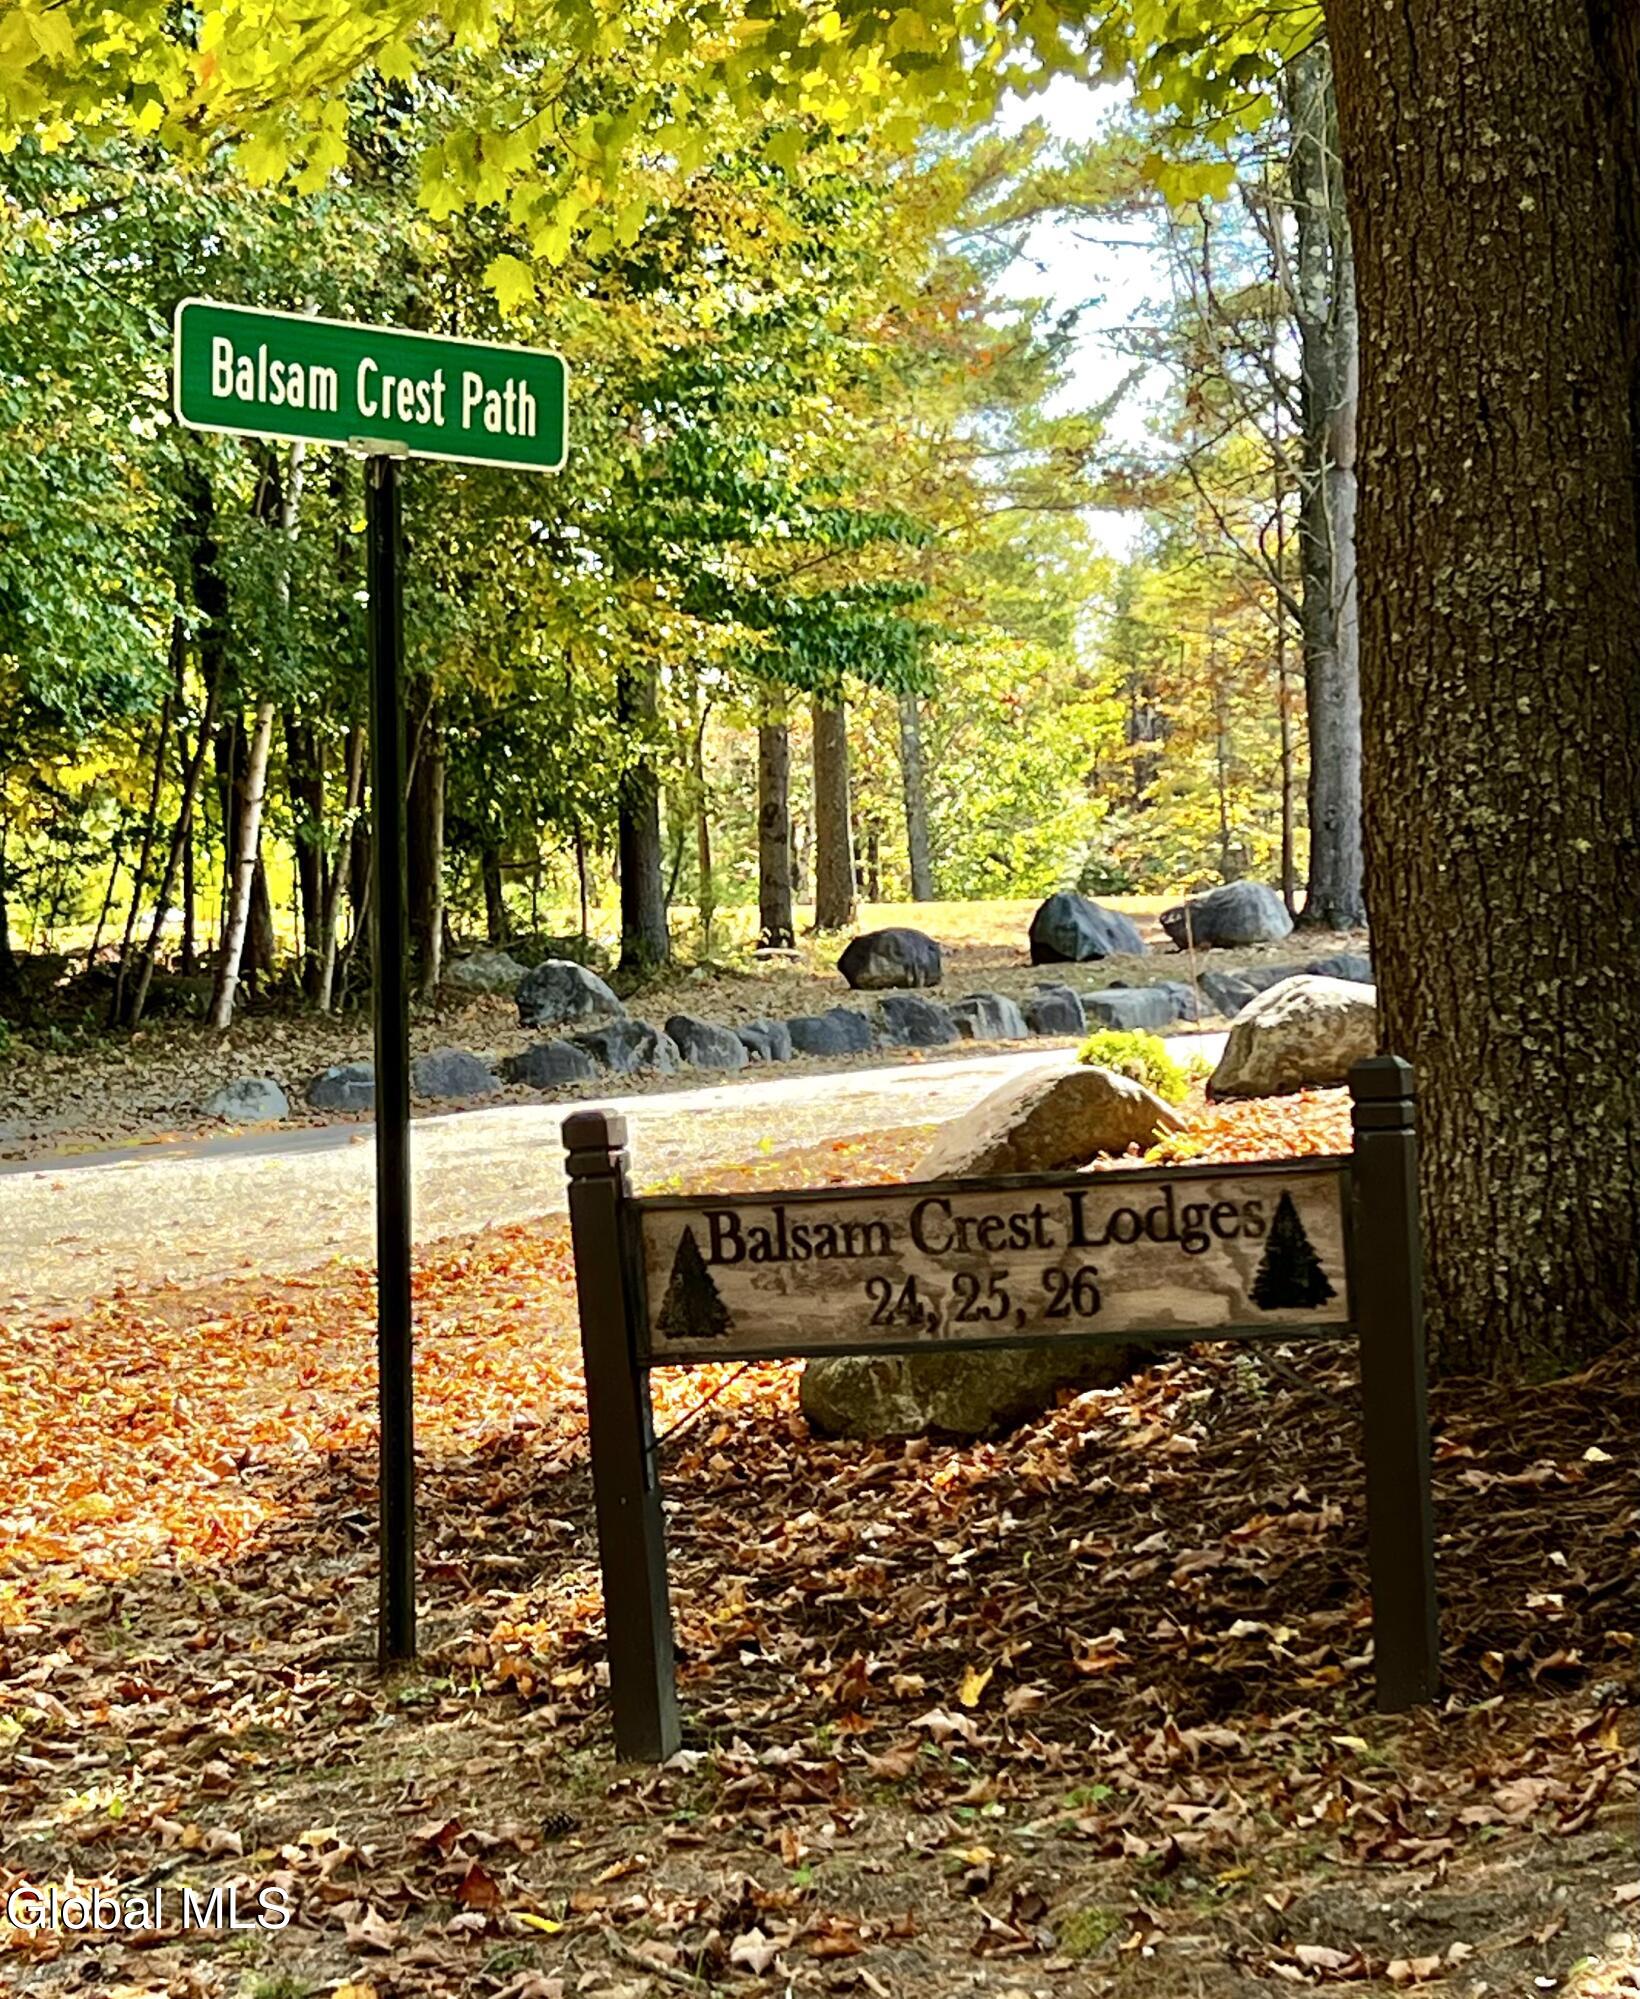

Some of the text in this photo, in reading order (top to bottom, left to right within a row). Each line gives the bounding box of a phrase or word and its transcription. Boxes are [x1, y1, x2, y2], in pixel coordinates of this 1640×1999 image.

[212, 336, 536, 437] Balsam Crest Path
[703, 1185, 1267, 1265] Balsam Crest Lodges
[866, 1265, 1101, 1333] 24, 25, 26
